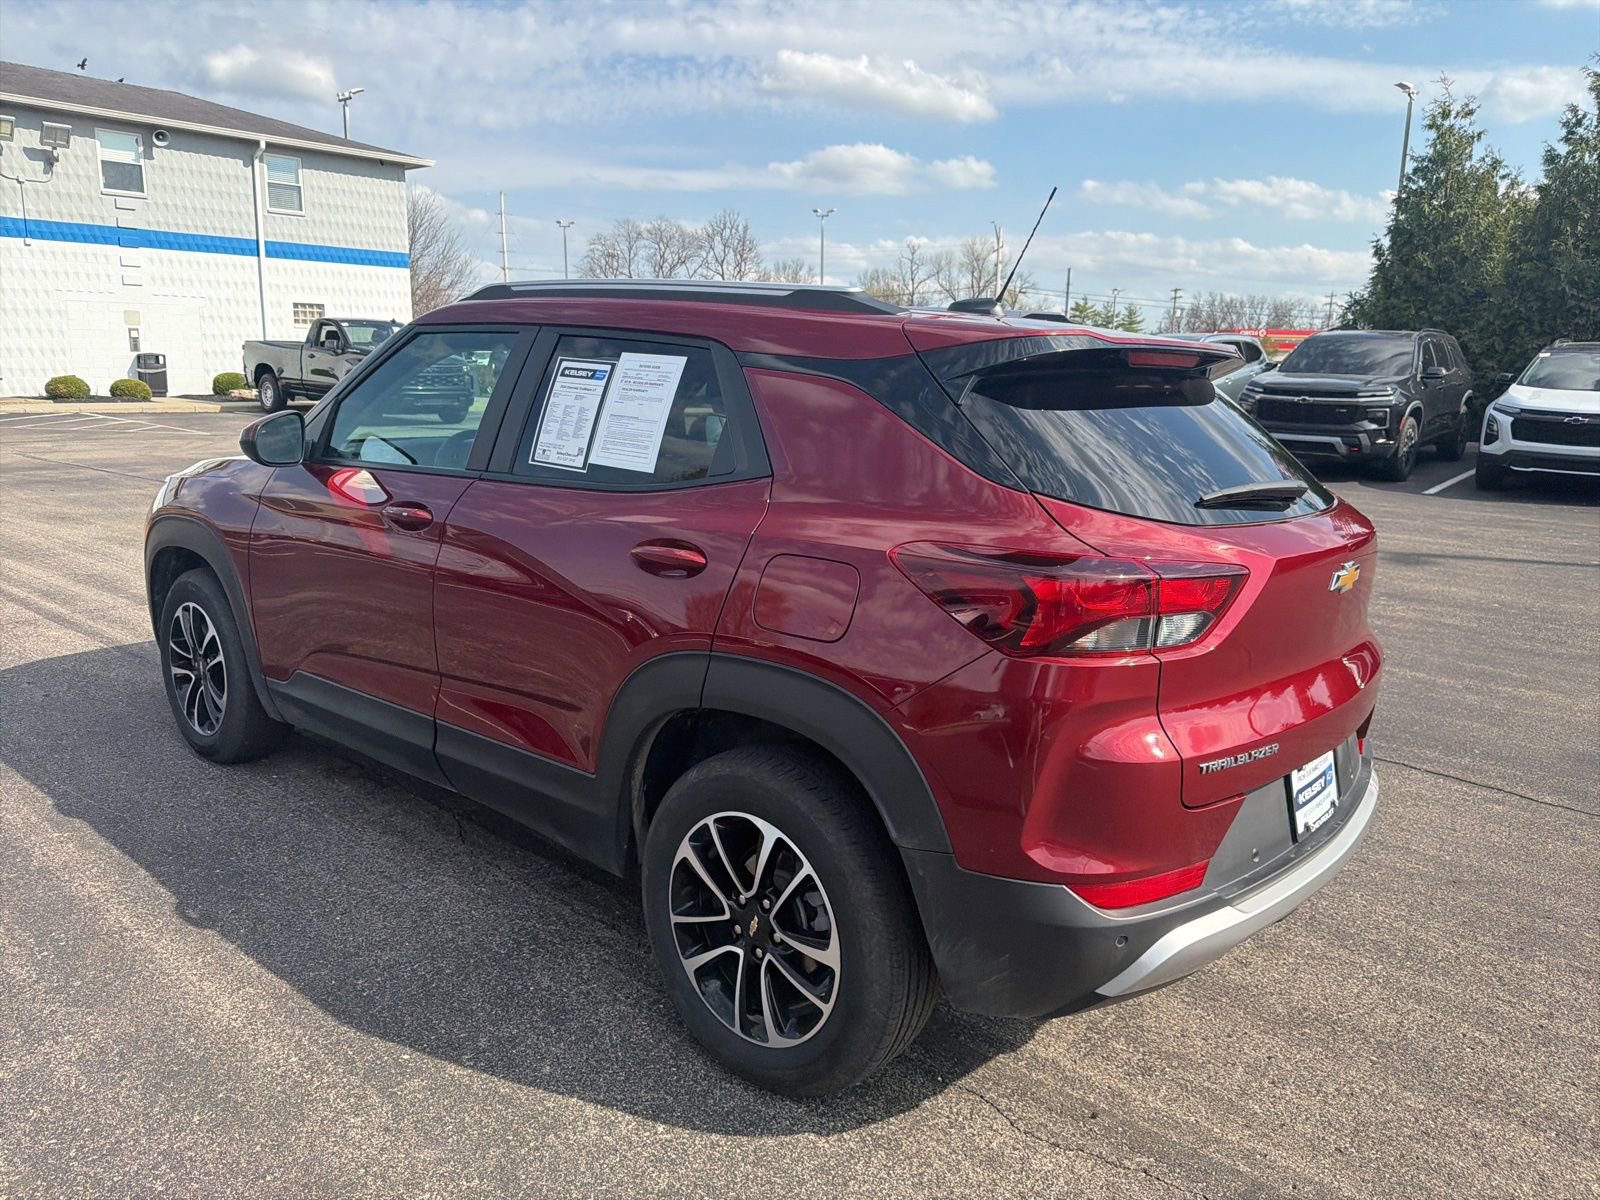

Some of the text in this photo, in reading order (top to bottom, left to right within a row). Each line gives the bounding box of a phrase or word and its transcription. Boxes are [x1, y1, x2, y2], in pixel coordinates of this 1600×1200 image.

[564, 369, 594, 377] KELSEY
[1198, 743, 1280, 775] TRAILBLAZER
[1298, 775, 1326, 805] KELSEY
